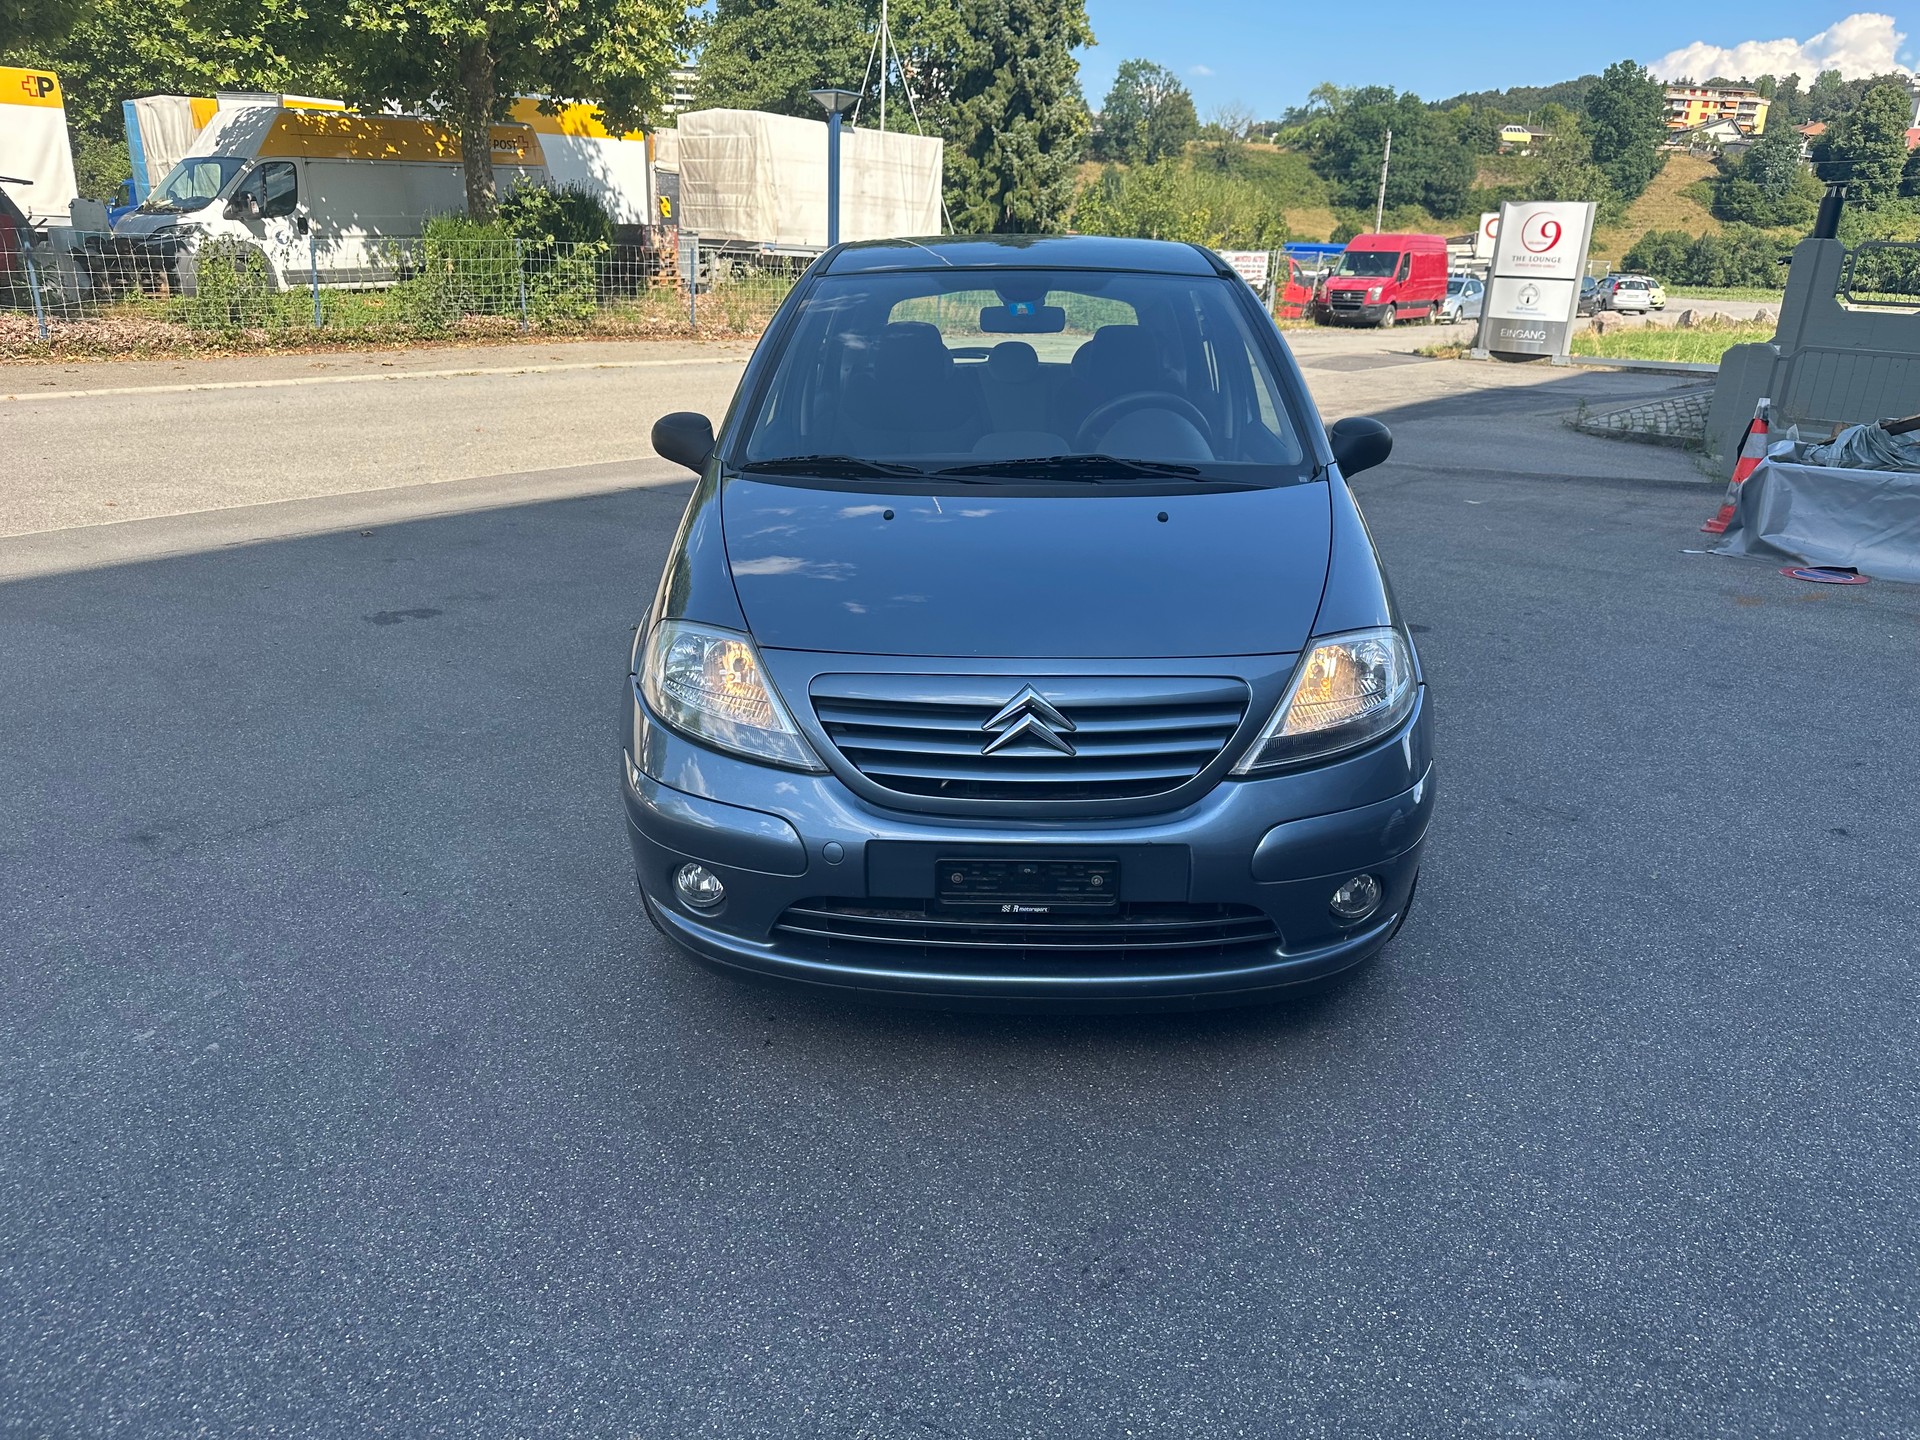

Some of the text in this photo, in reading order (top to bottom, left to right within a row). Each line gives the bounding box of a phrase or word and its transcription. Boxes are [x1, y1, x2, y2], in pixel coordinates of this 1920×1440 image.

[37, 76, 54, 98] P
[493, 139, 517, 149] POST
[1529, 256, 1562, 264] LOUNGE
[1500, 327, 1546, 340] EINGANG
